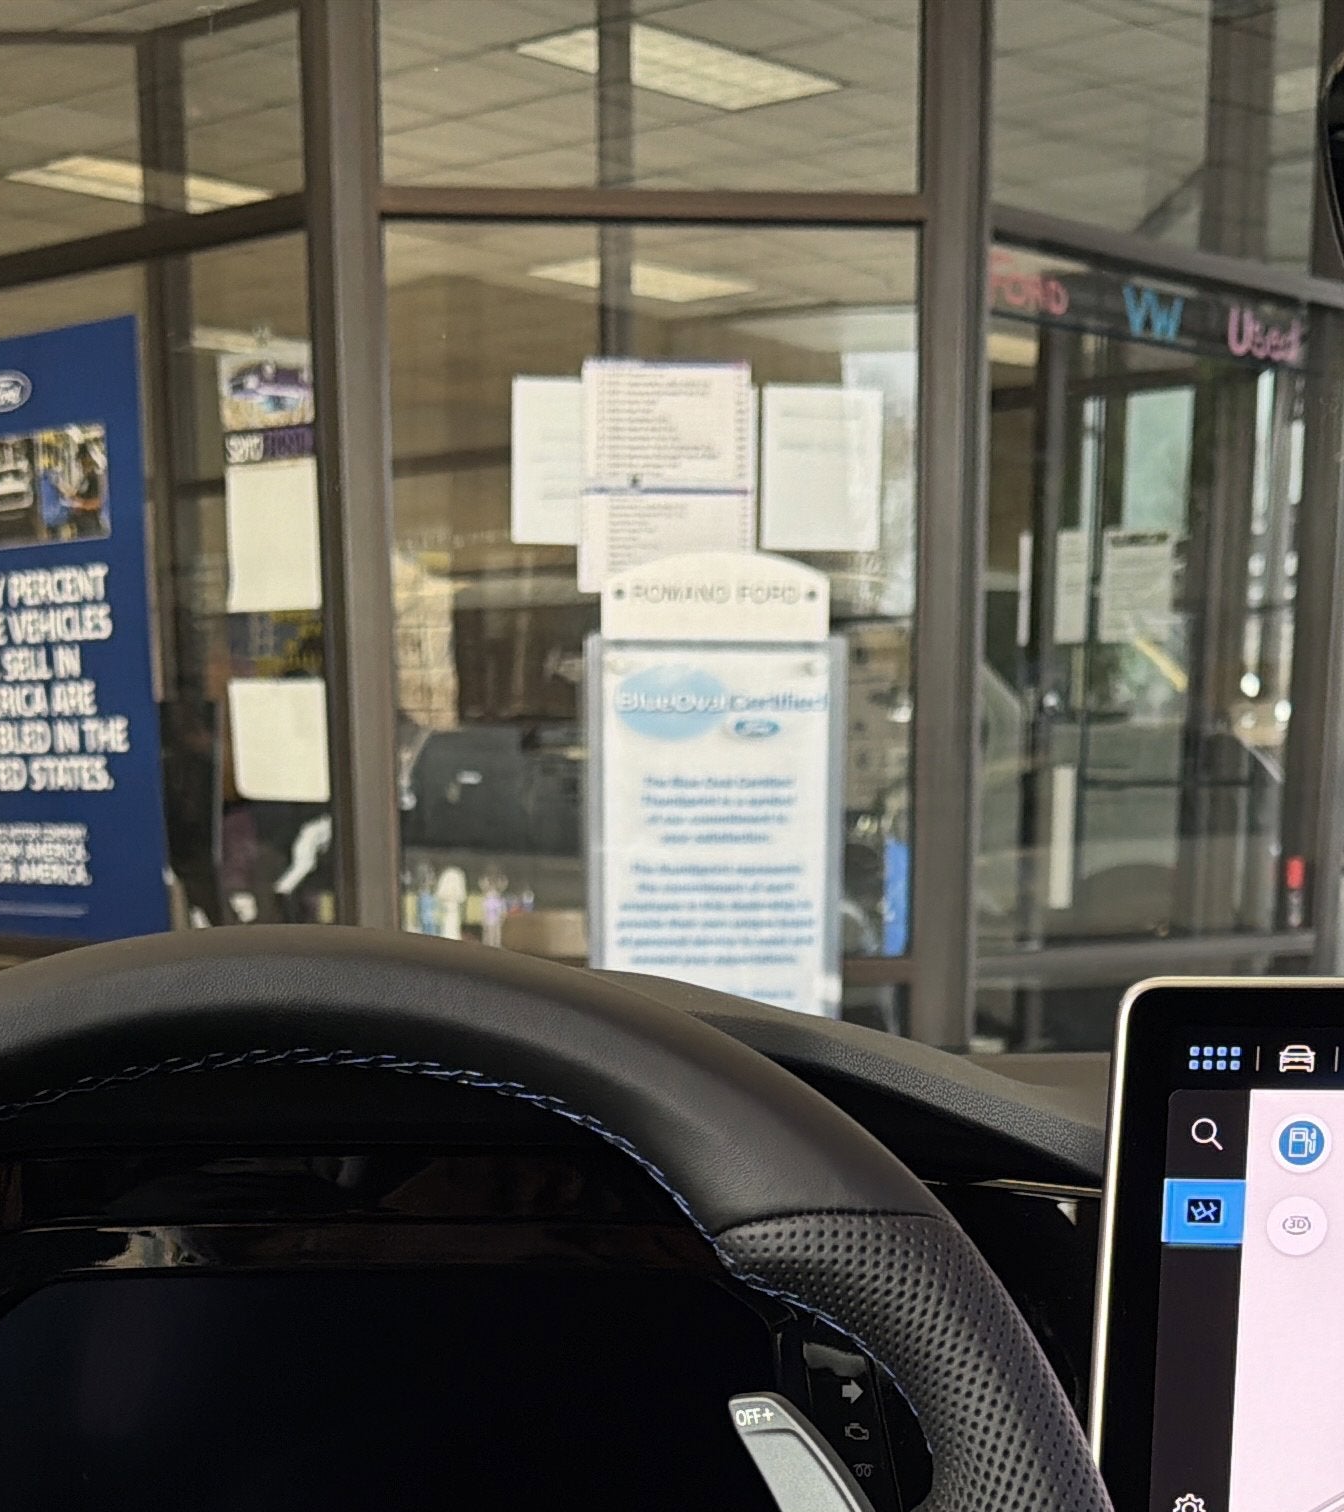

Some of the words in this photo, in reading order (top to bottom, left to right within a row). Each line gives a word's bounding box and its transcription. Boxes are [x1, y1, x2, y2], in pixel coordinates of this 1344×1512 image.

[1121, 284, 1183, 343] VW
[8, 563, 109, 607] PERCENT
[7, 602, 112, 644] VEHICLES
[2, 645, 52, 681] SELL
[53, 644, 81, 678] IN
[51, 679, 97, 716] ARE
[53, 718, 80, 752] IN
[83, 715, 130, 752] THE
[1288, 1219, 1307, 1230] 3D
